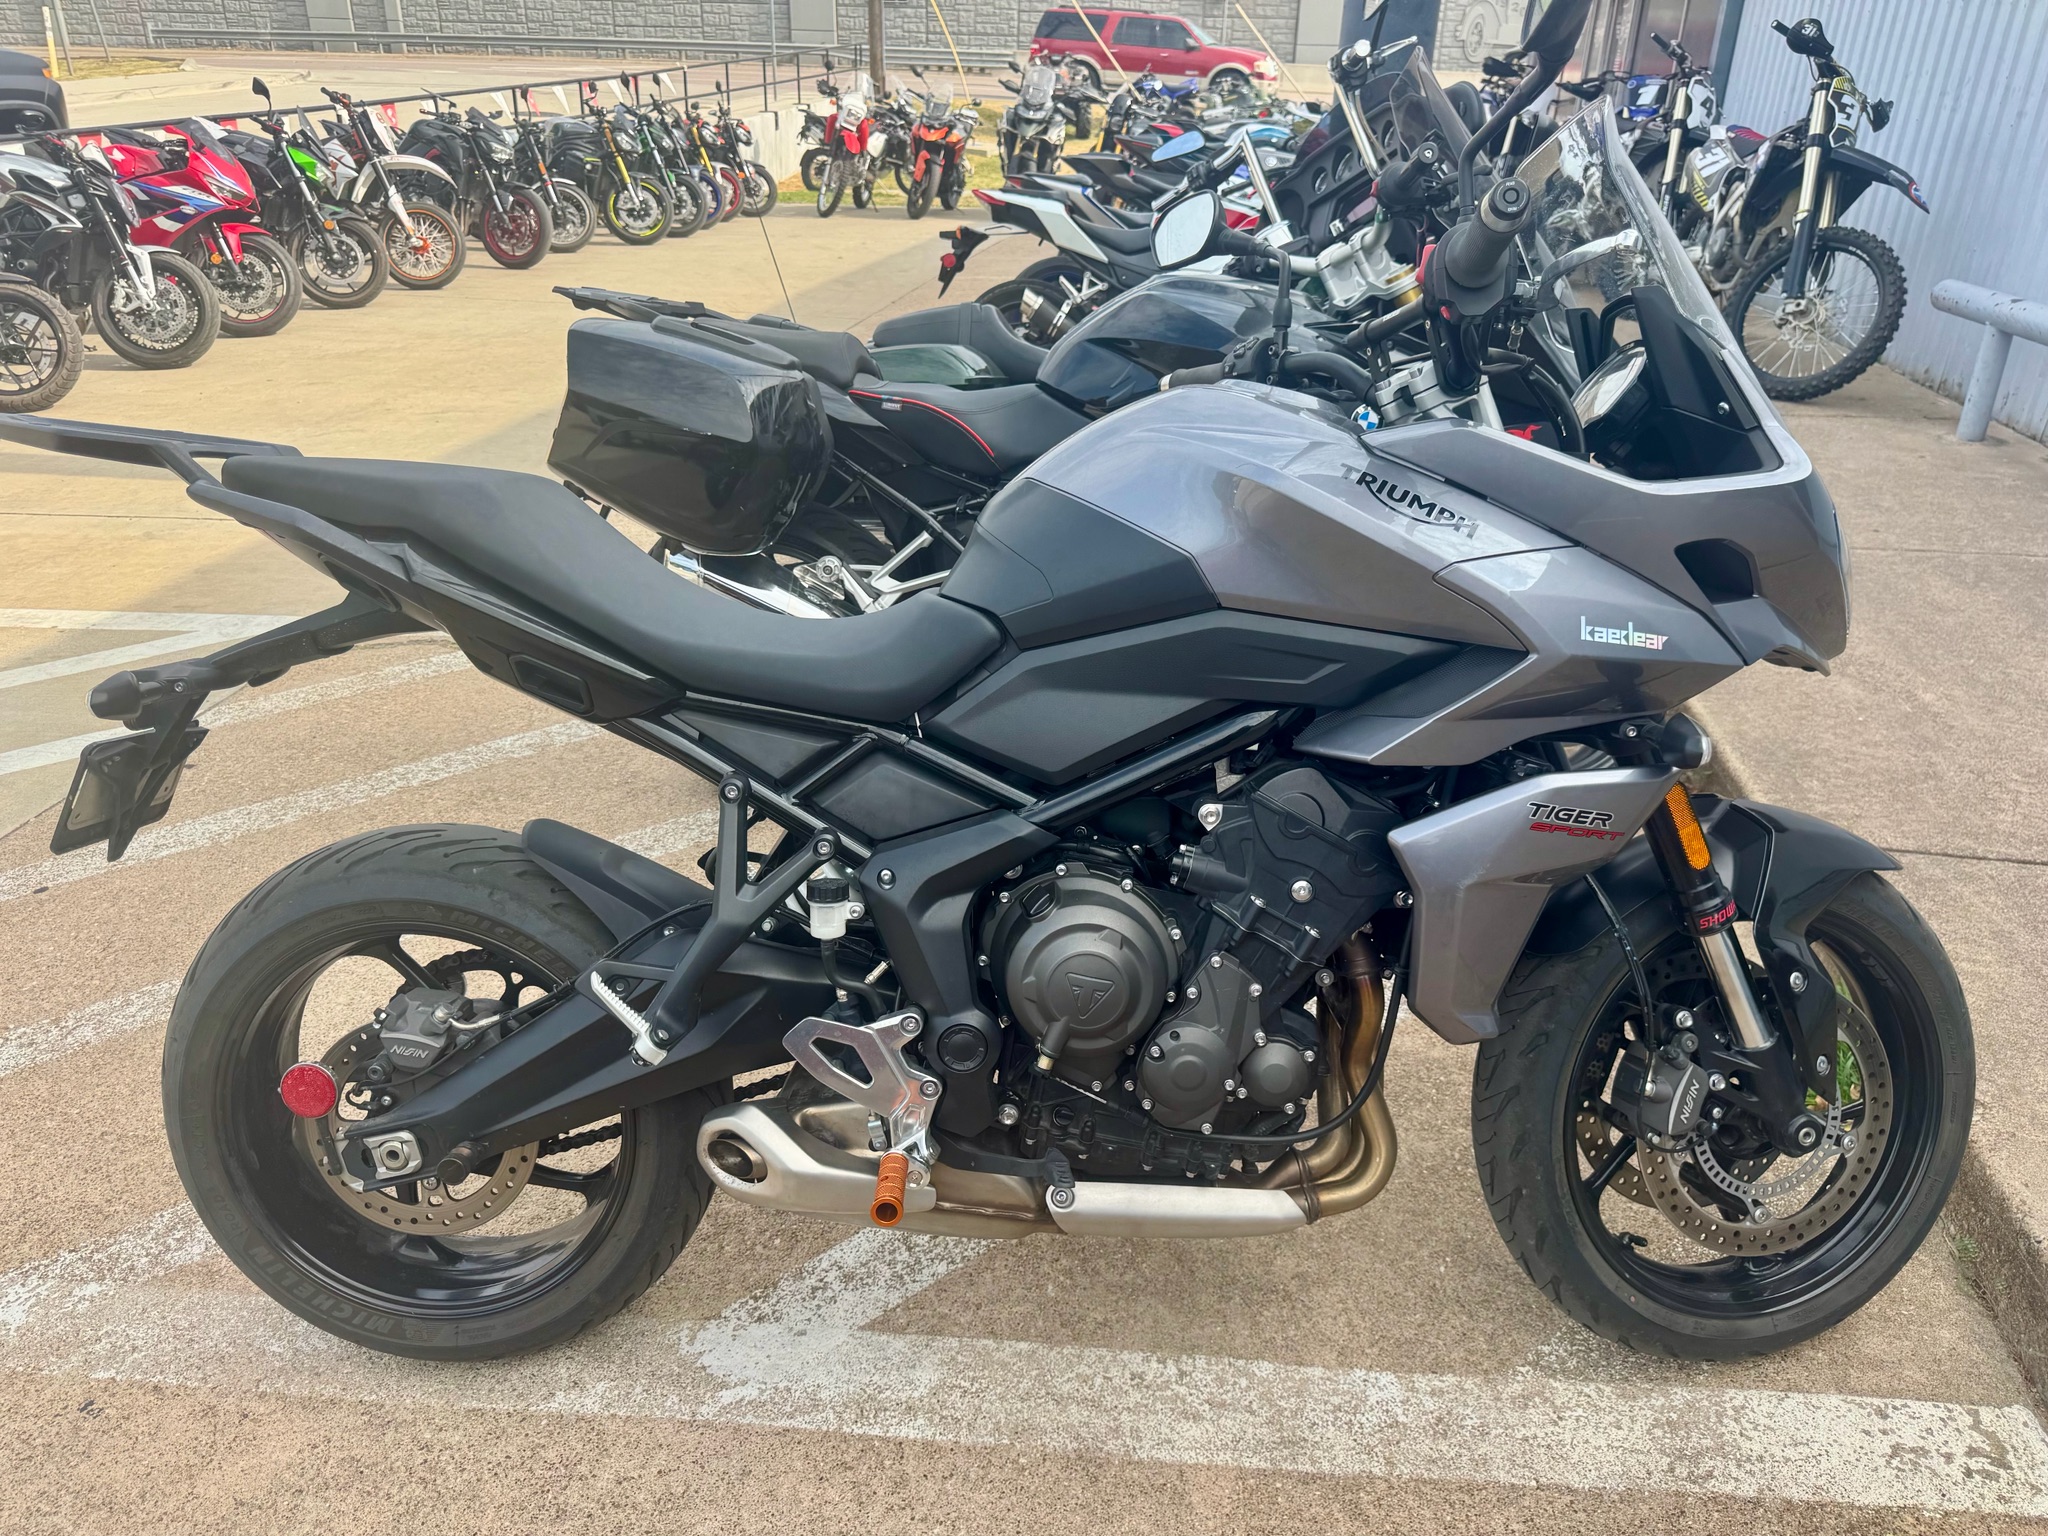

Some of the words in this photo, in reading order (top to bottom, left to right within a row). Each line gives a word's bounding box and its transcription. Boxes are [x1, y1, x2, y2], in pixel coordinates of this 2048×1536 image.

[1340, 462, 1479, 540] TRIUMPH
[1527, 801, 1614, 829] TIGER
[1529, 821, 1625, 841] SPORT
[449, 908, 570, 976] MICHEL
[390, 1044, 430, 1059] NISSIN
[1680, 1078, 1700, 1124] NISSIN
[249, 1243, 396, 1334] MICHELIN
